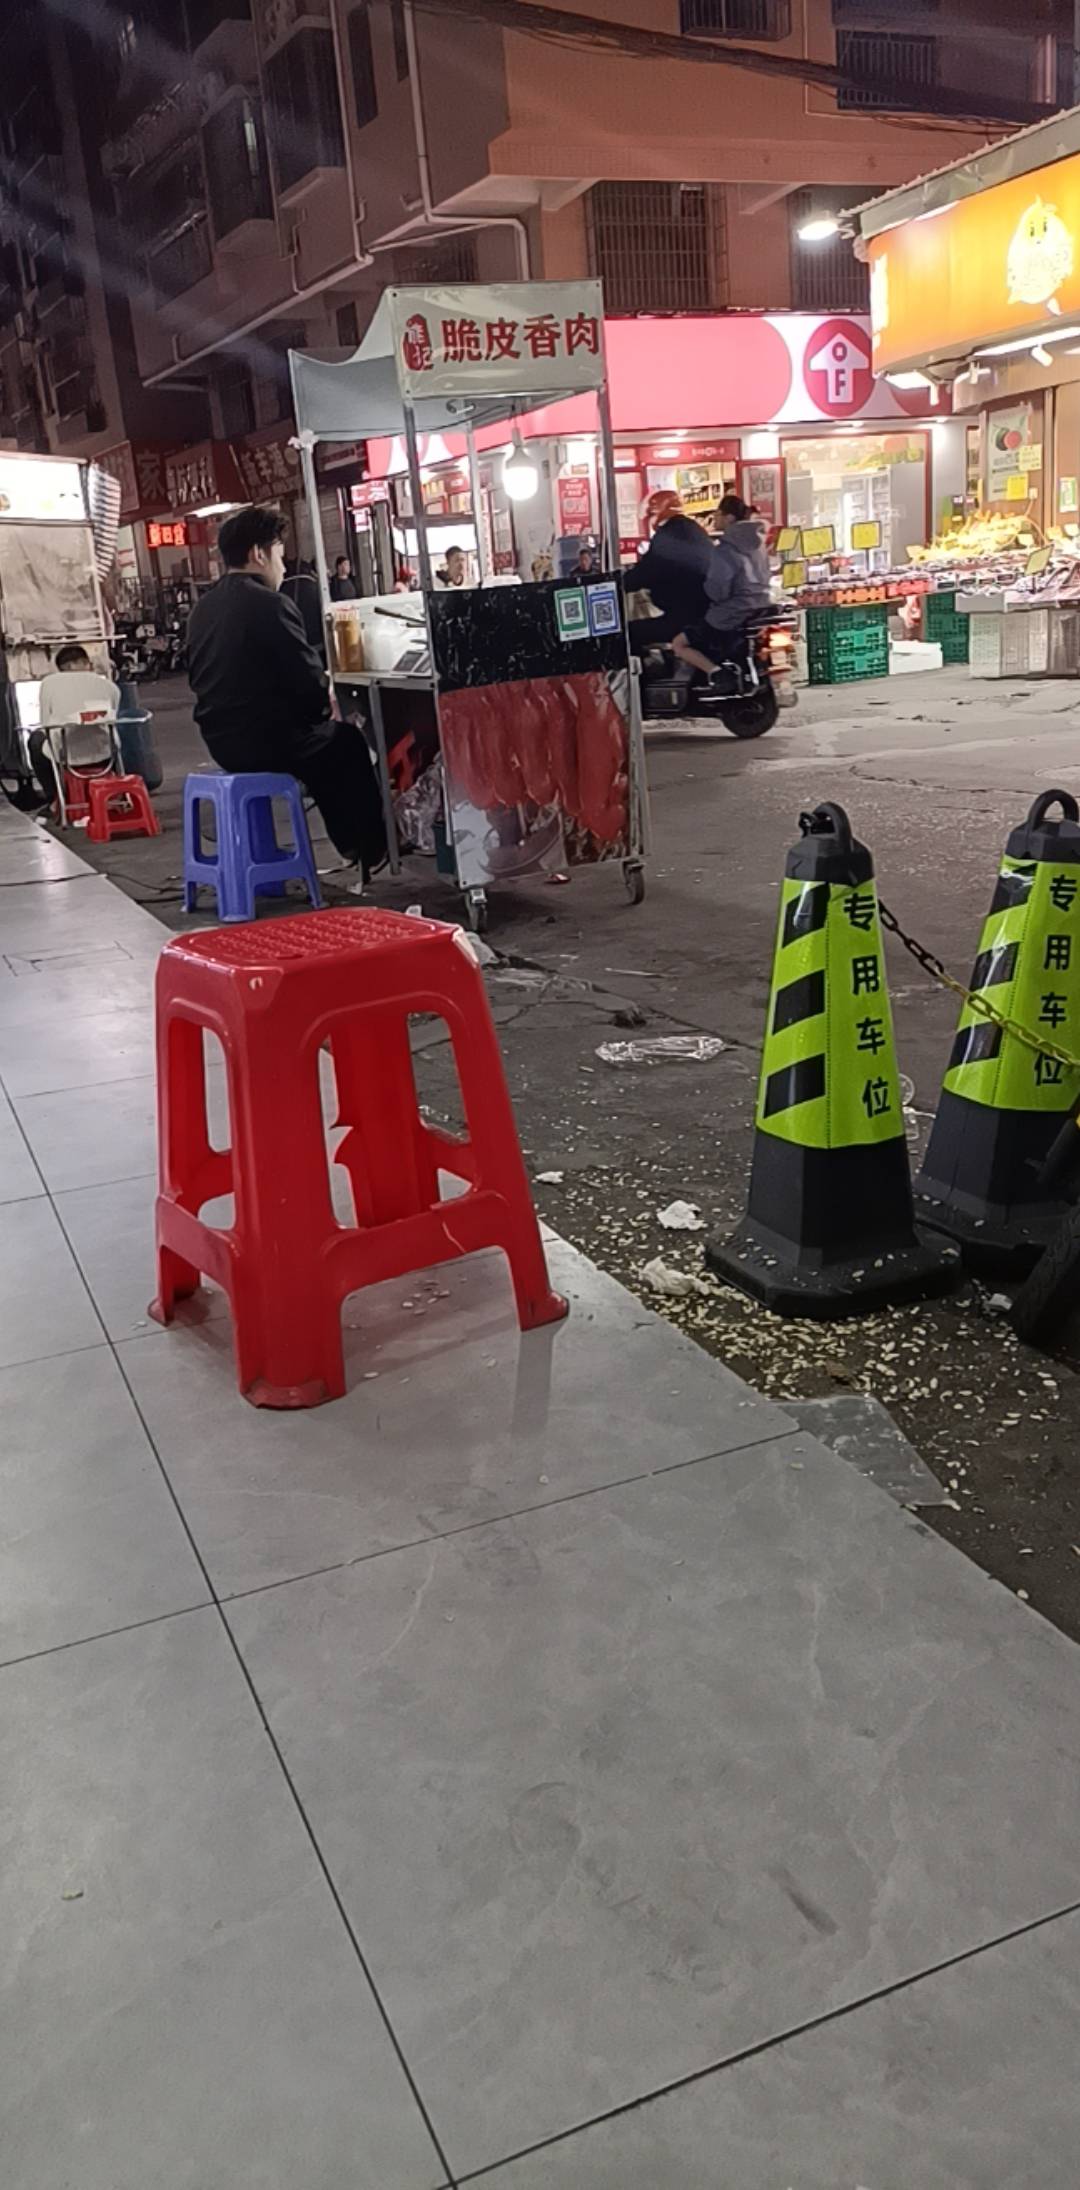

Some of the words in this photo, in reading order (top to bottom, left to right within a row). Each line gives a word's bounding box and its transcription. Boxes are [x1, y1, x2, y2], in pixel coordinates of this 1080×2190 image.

[441, 311, 600, 363] 脆皮香肉
[843, 892, 891, 1119] 专用车位
[1033, 874, 1078, 1086] 专用车位
